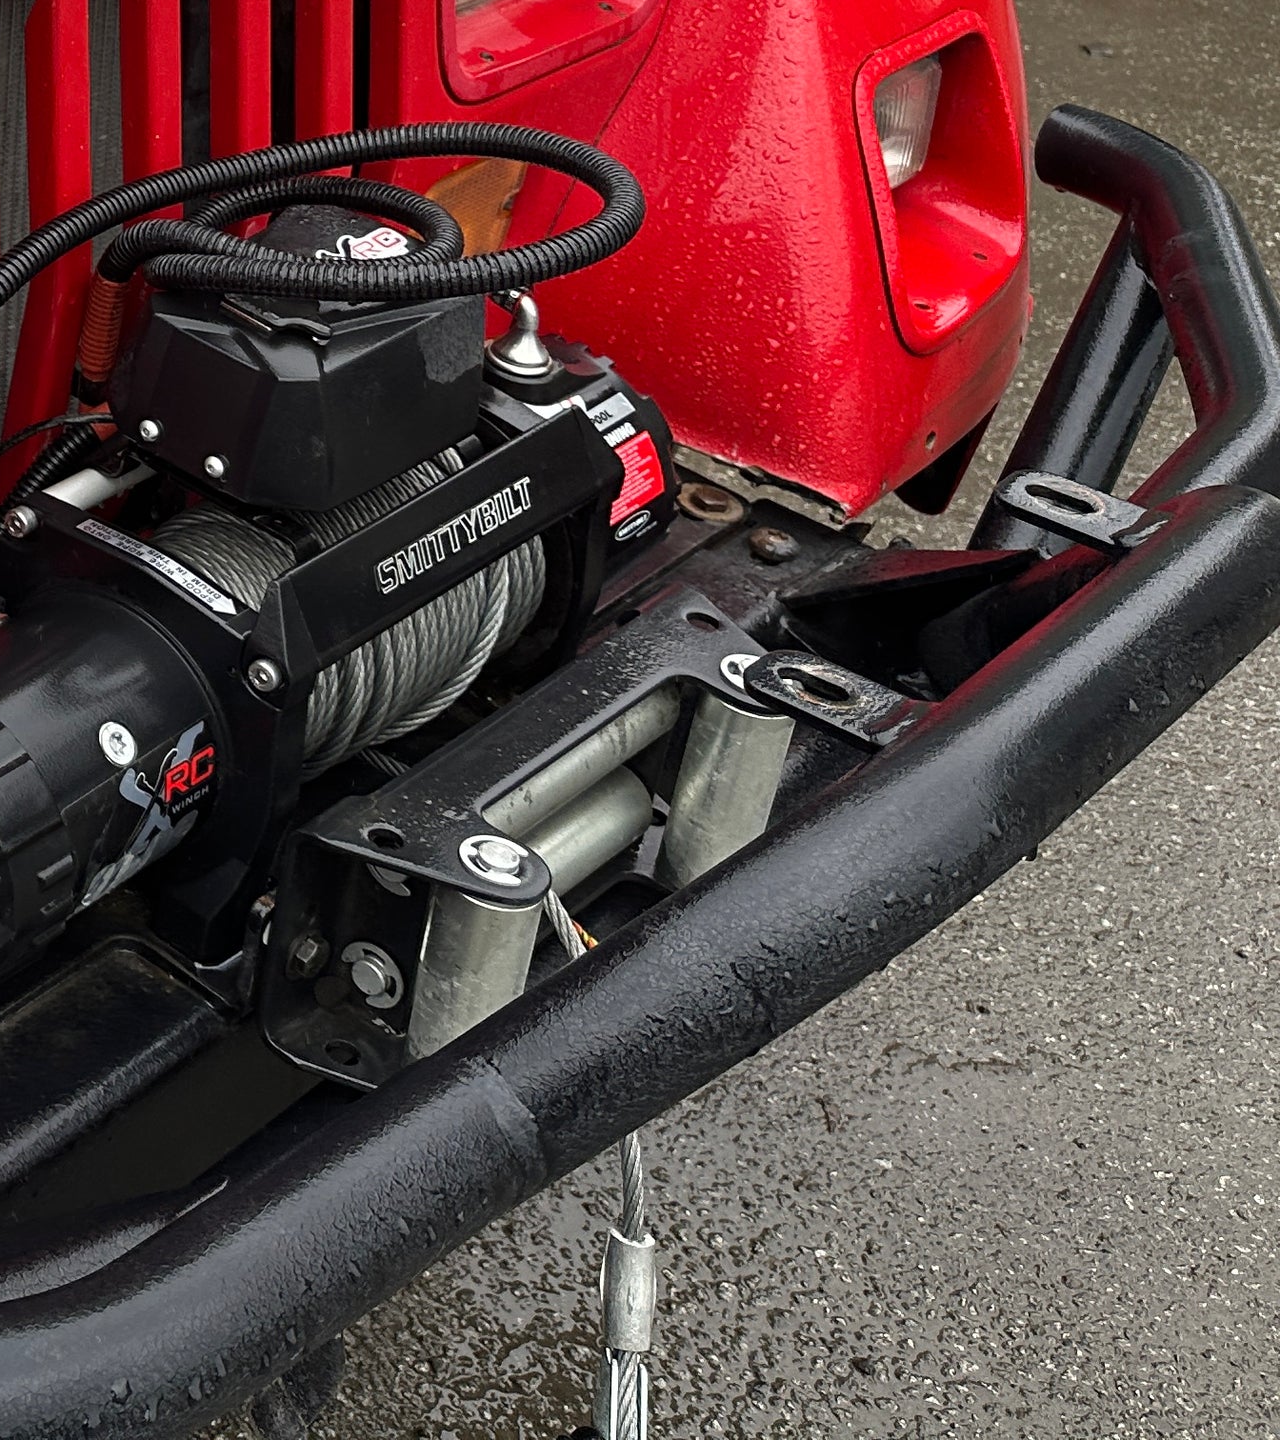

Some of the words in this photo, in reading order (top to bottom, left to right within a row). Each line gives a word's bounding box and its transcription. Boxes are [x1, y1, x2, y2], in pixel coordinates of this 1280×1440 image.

[83, 525, 112, 541] ONTO
[90, 521, 144, 550] DIRECTION
[376, 475, 533, 595] SMITTYBILT
[117, 540, 144, 558] ROPE
[147, 548, 172, 566] THIS
[150, 557, 176, 577] WIRE
[175, 565, 189, 578] IN
[181, 577, 214, 605] SPOOL
[191, 576, 222, 601] DRUM
[170, 786, 211, 815] WINCH
